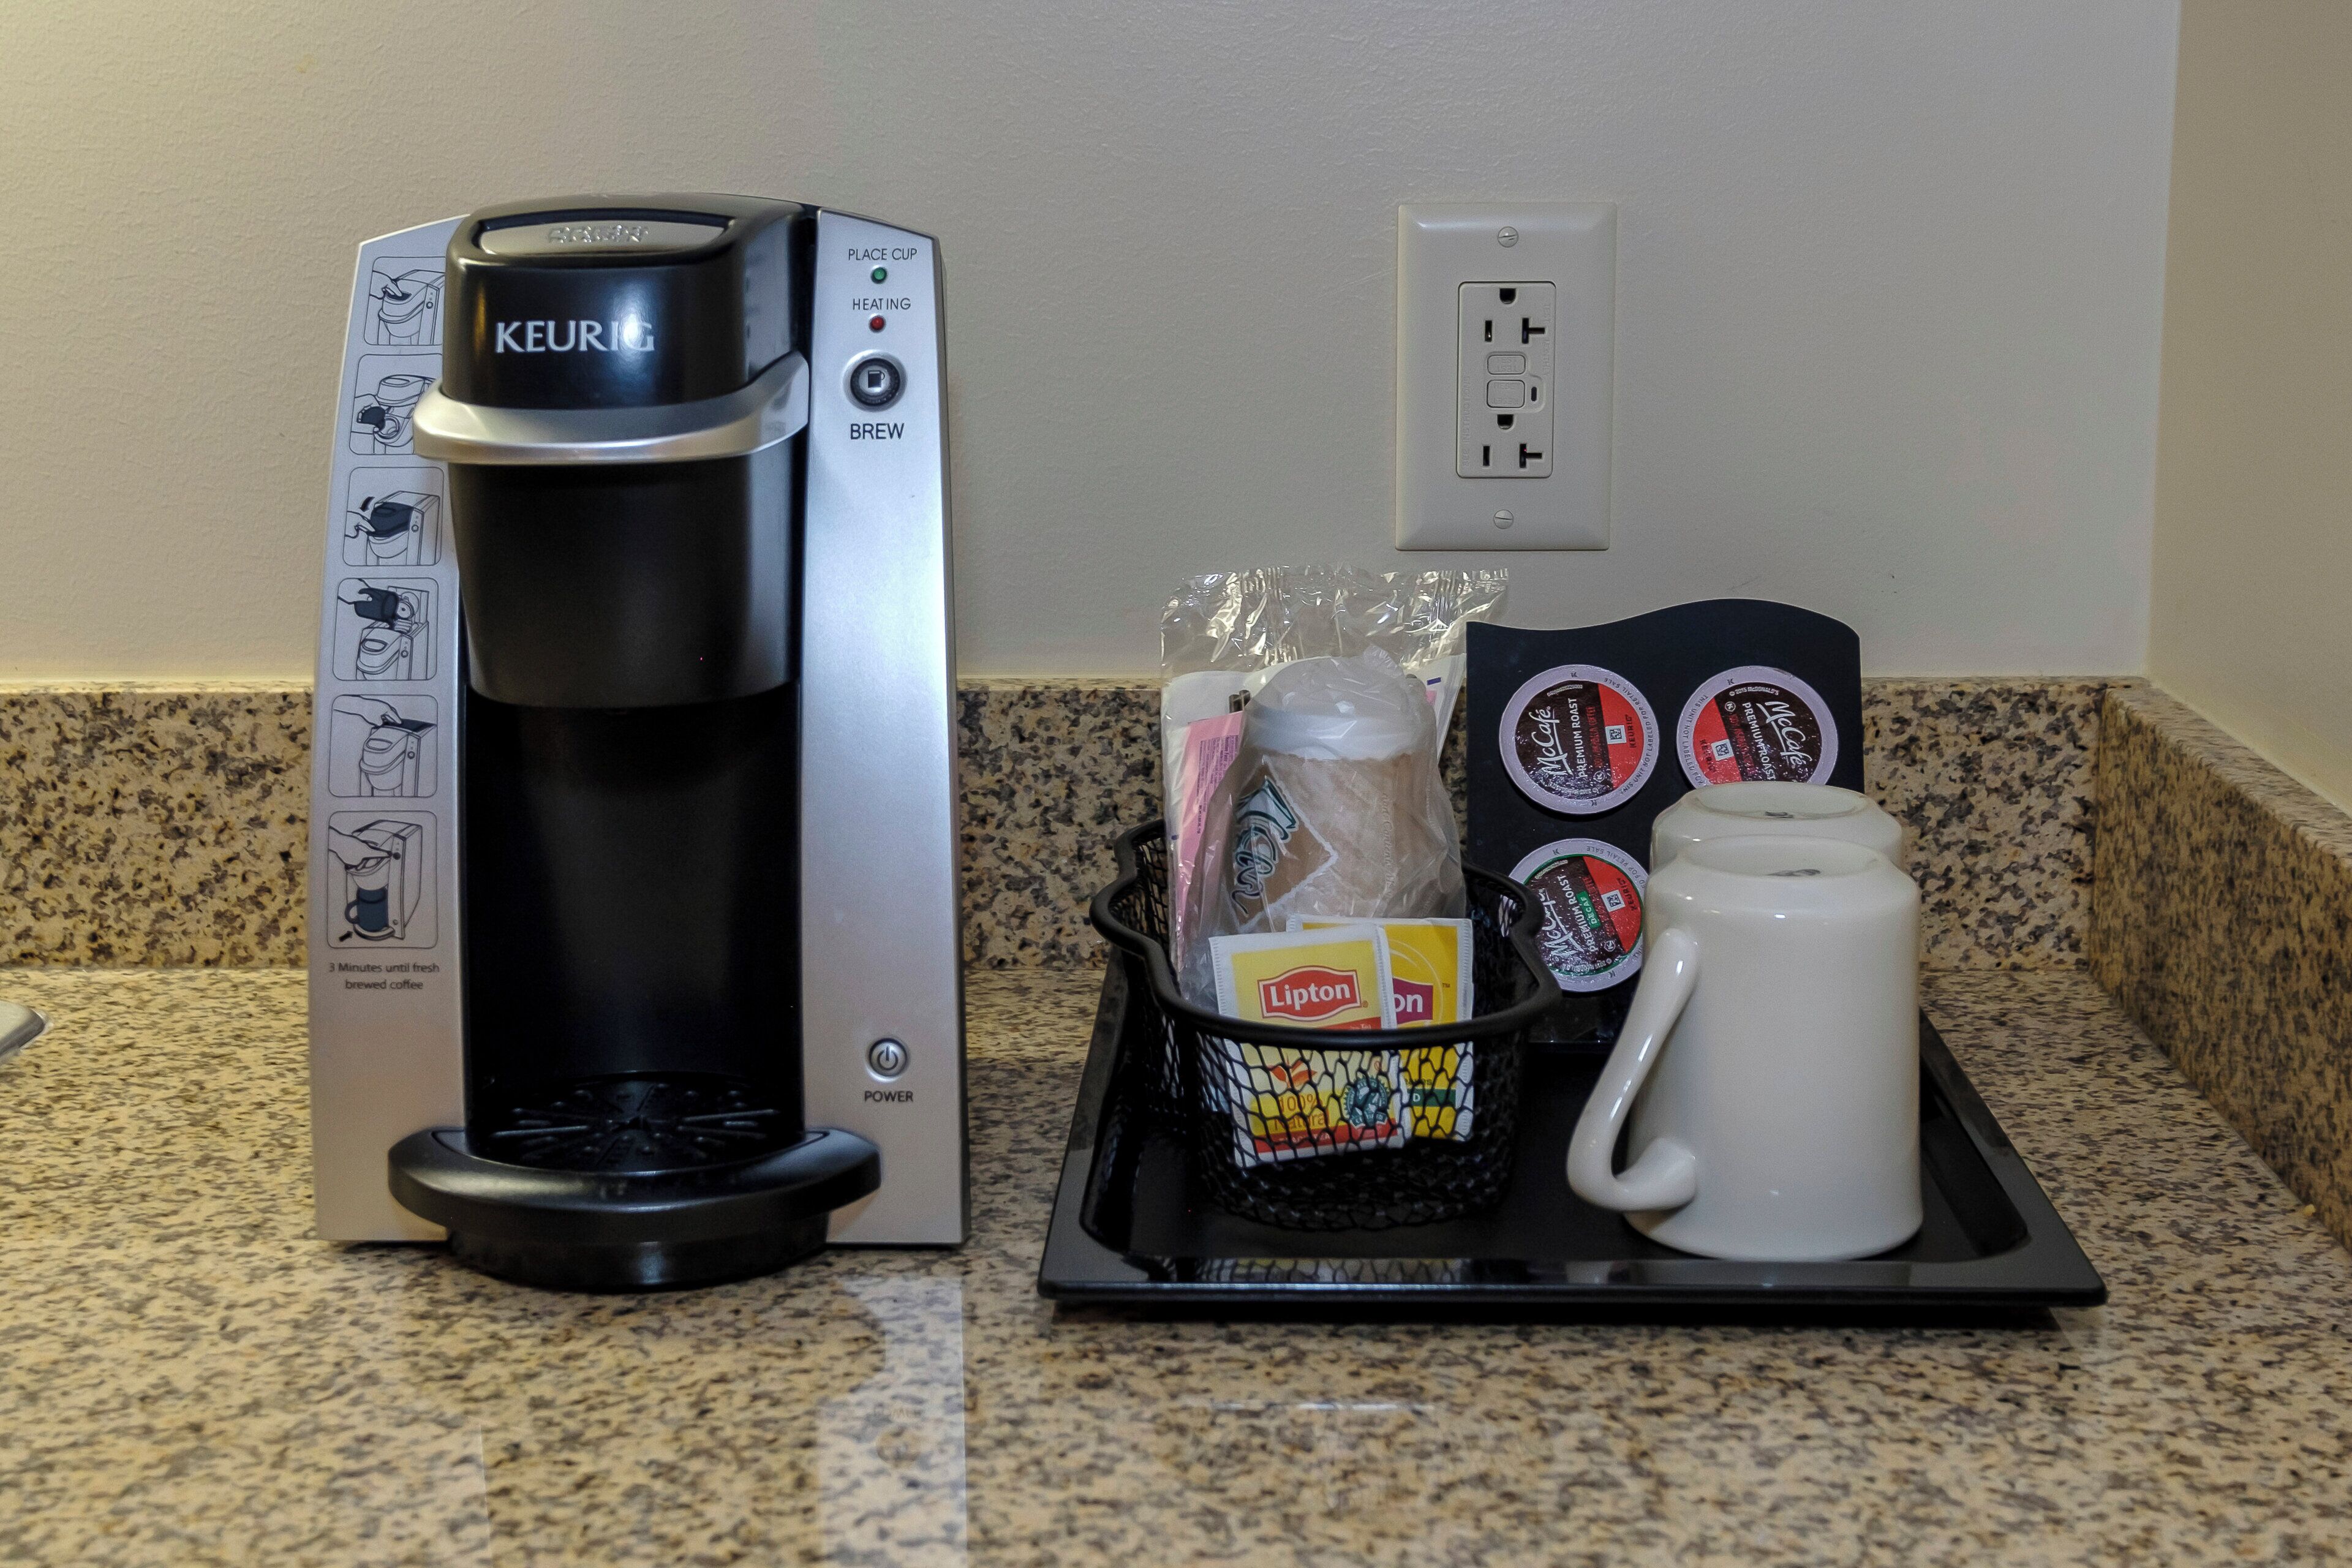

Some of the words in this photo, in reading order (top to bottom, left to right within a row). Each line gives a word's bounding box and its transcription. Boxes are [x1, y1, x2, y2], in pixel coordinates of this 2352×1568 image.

[848, 248, 888, 260] PLACE
[892, 248, 918, 260] CUP
[853, 298, 911, 310] HEATING
[494, 320, 655, 353] KEURIG
[850, 423, 905, 440] BREW
[1604, 677, 1621, 688] SALE
[1622, 687, 1640, 706] RETAIL
[1695, 695, 1708, 707] THIS
[1568, 698, 1581, 728] ROAST
[1638, 706, 1649, 719] FOR
[1687, 708, 1697, 723] UNIT
[1743, 702, 1765, 747] PREMIUM
[1758, 747, 1776, 780] ROAST
[1573, 731, 1588, 778] PREMIUM
[1643, 753, 1651, 767] NOT
[1683, 741, 1695, 771] LABELED
[1633, 767, 1645, 783] UNIT
[1586, 846, 1604, 854] SALE
[1557, 875, 1578, 905] ROAST
[1580, 897, 1597, 924] DECAF
[1572, 906, 1599, 951] PREMIUM
[329, 962, 335, 972] 3
[338, 962, 382, 973] Minutes
[386, 962, 410, 973] until
[412, 962, 439, 973] fresh
[345, 979, 386, 989] brewed
[390, 979, 423, 989] coffee
[1269, 982, 1351, 1011] Lipton
[864, 1091, 913, 1102] POWER
